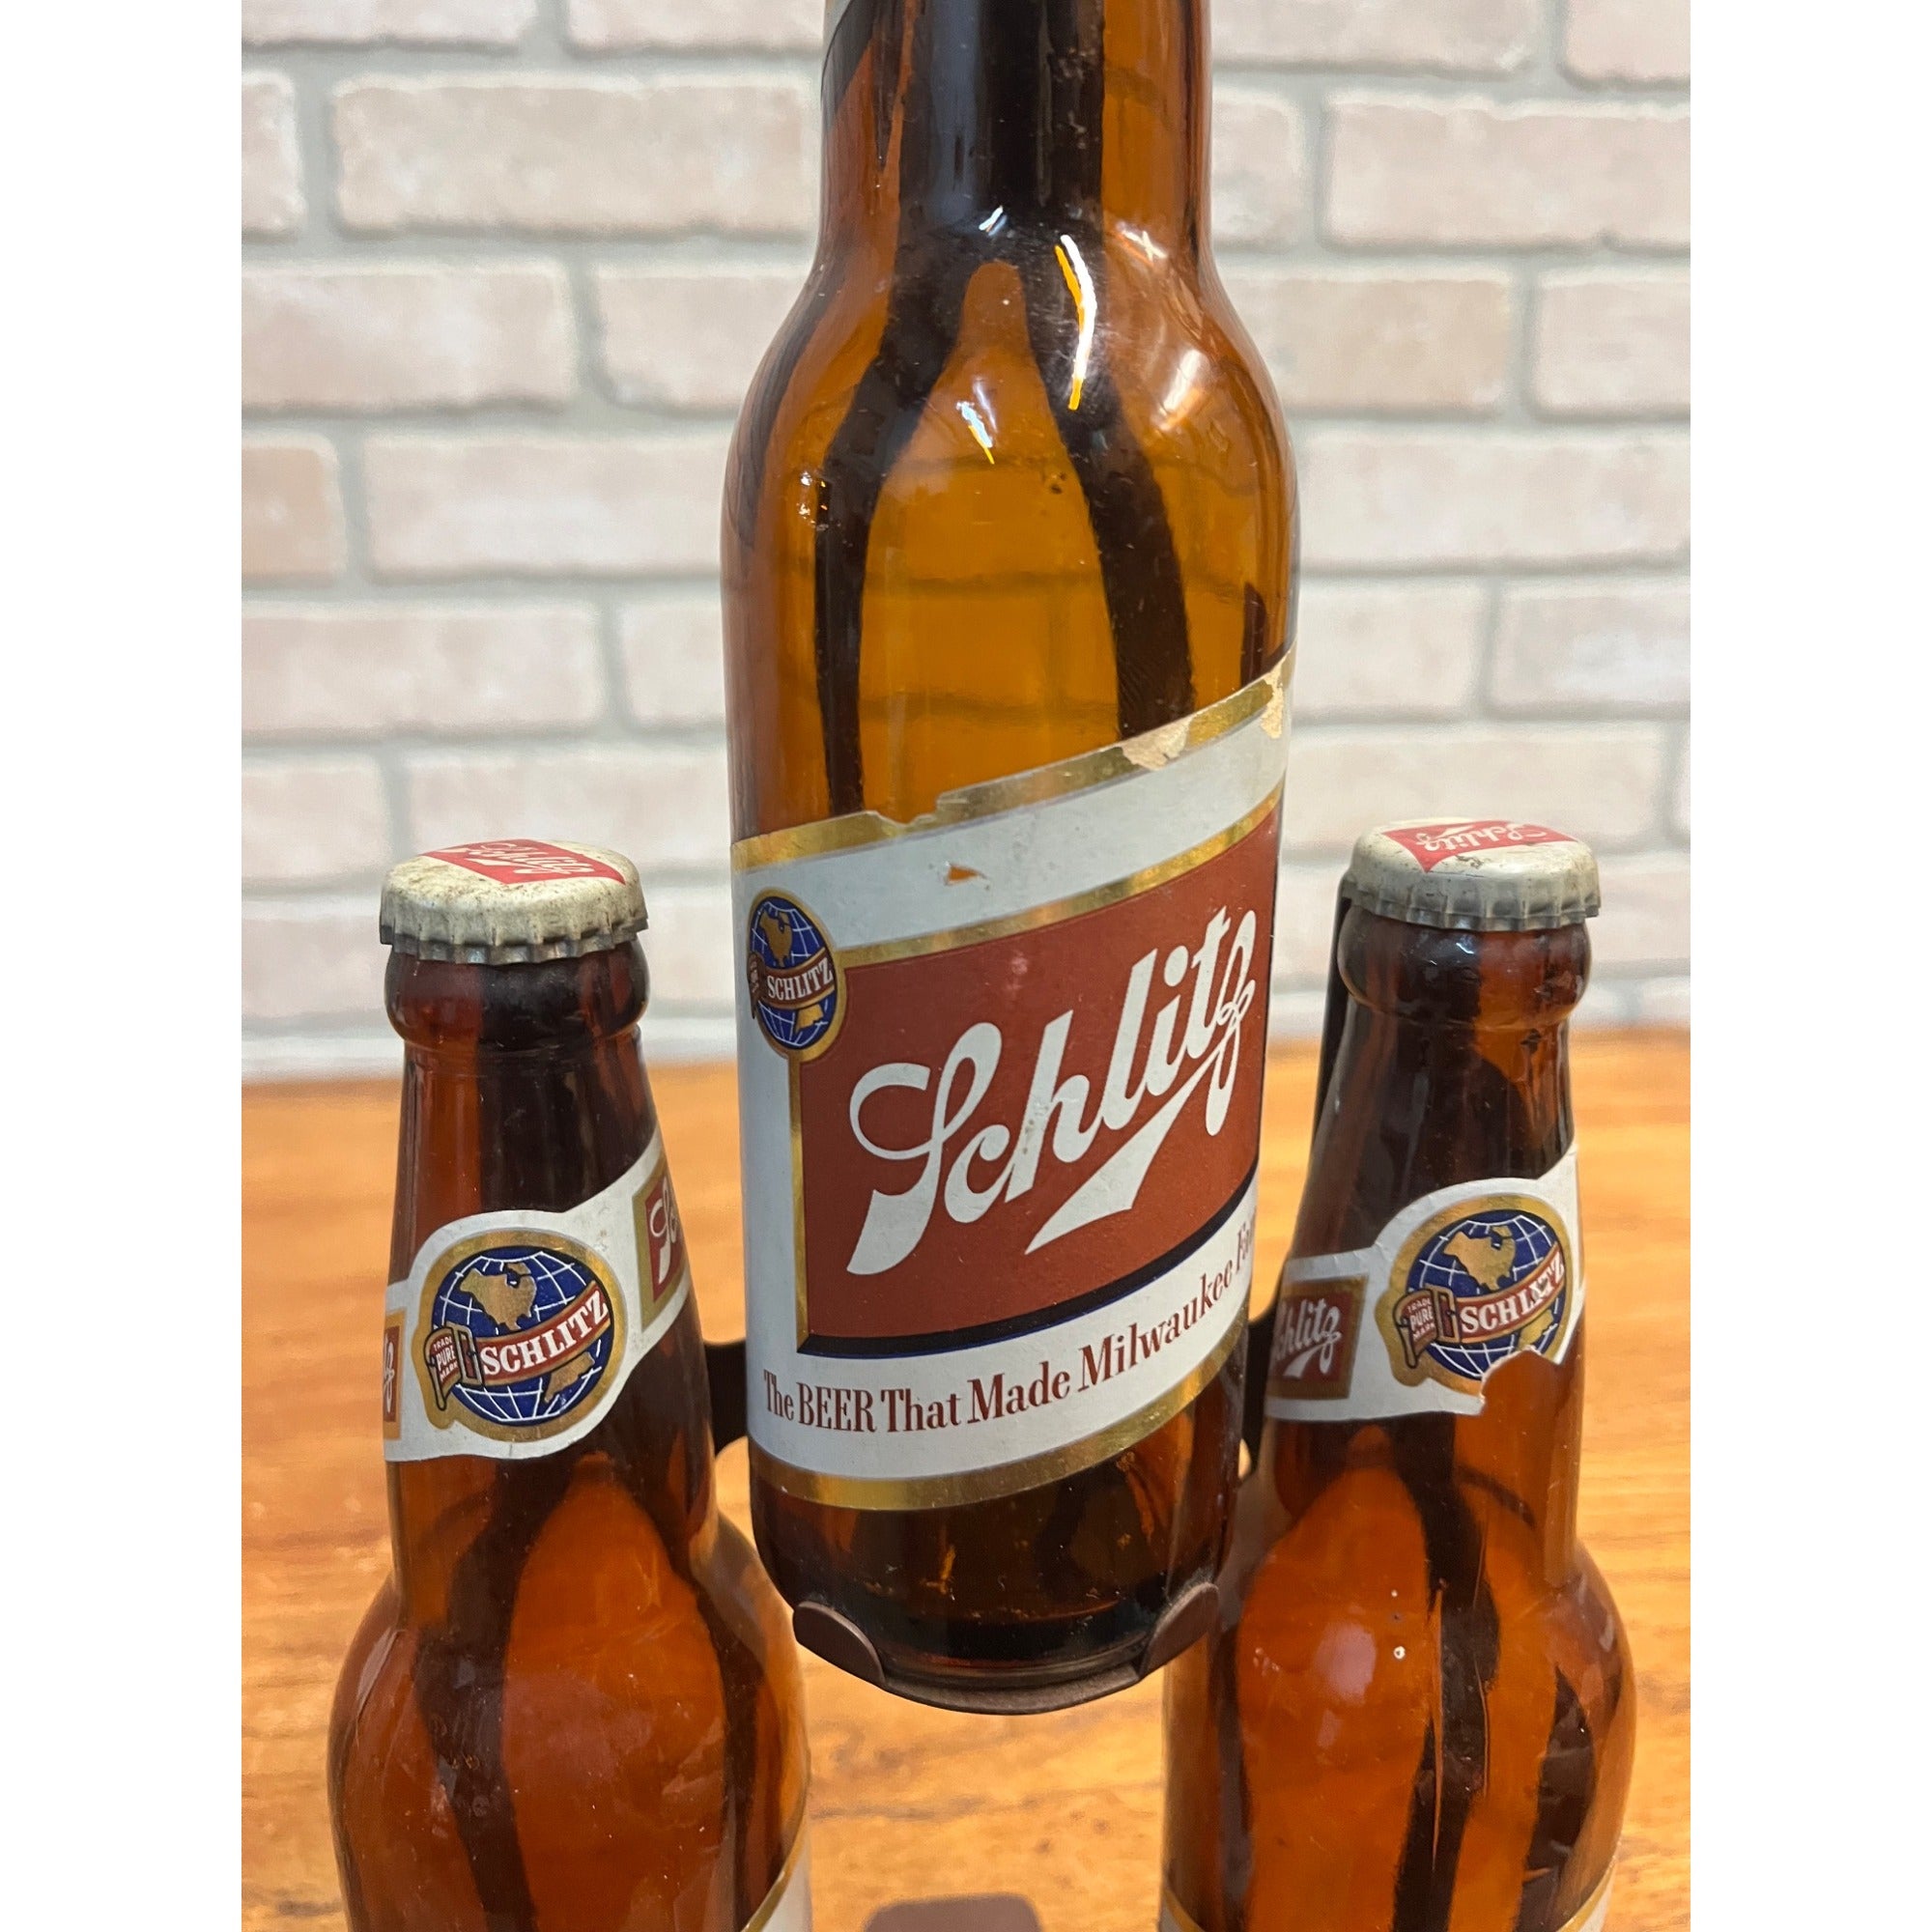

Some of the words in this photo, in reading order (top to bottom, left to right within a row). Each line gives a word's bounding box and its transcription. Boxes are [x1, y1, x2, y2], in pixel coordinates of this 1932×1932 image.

[767, 957, 834, 1001] SCHLITZ
[846, 905, 1257, 1275] Schlitz
[480, 1290, 609, 1377] SCHLITZ
[1410, 1305, 1434, 1332] PURE
[1460, 1251, 1566, 1334] SCHLITZ
[763, 1369, 794, 1421] The
[796, 1381, 877, 1434] BEER
[881, 1388, 962, 1434] That
[966, 1361, 1071, 1425] Made
[1078, 1259, 1234, 1392] Milwaukee
